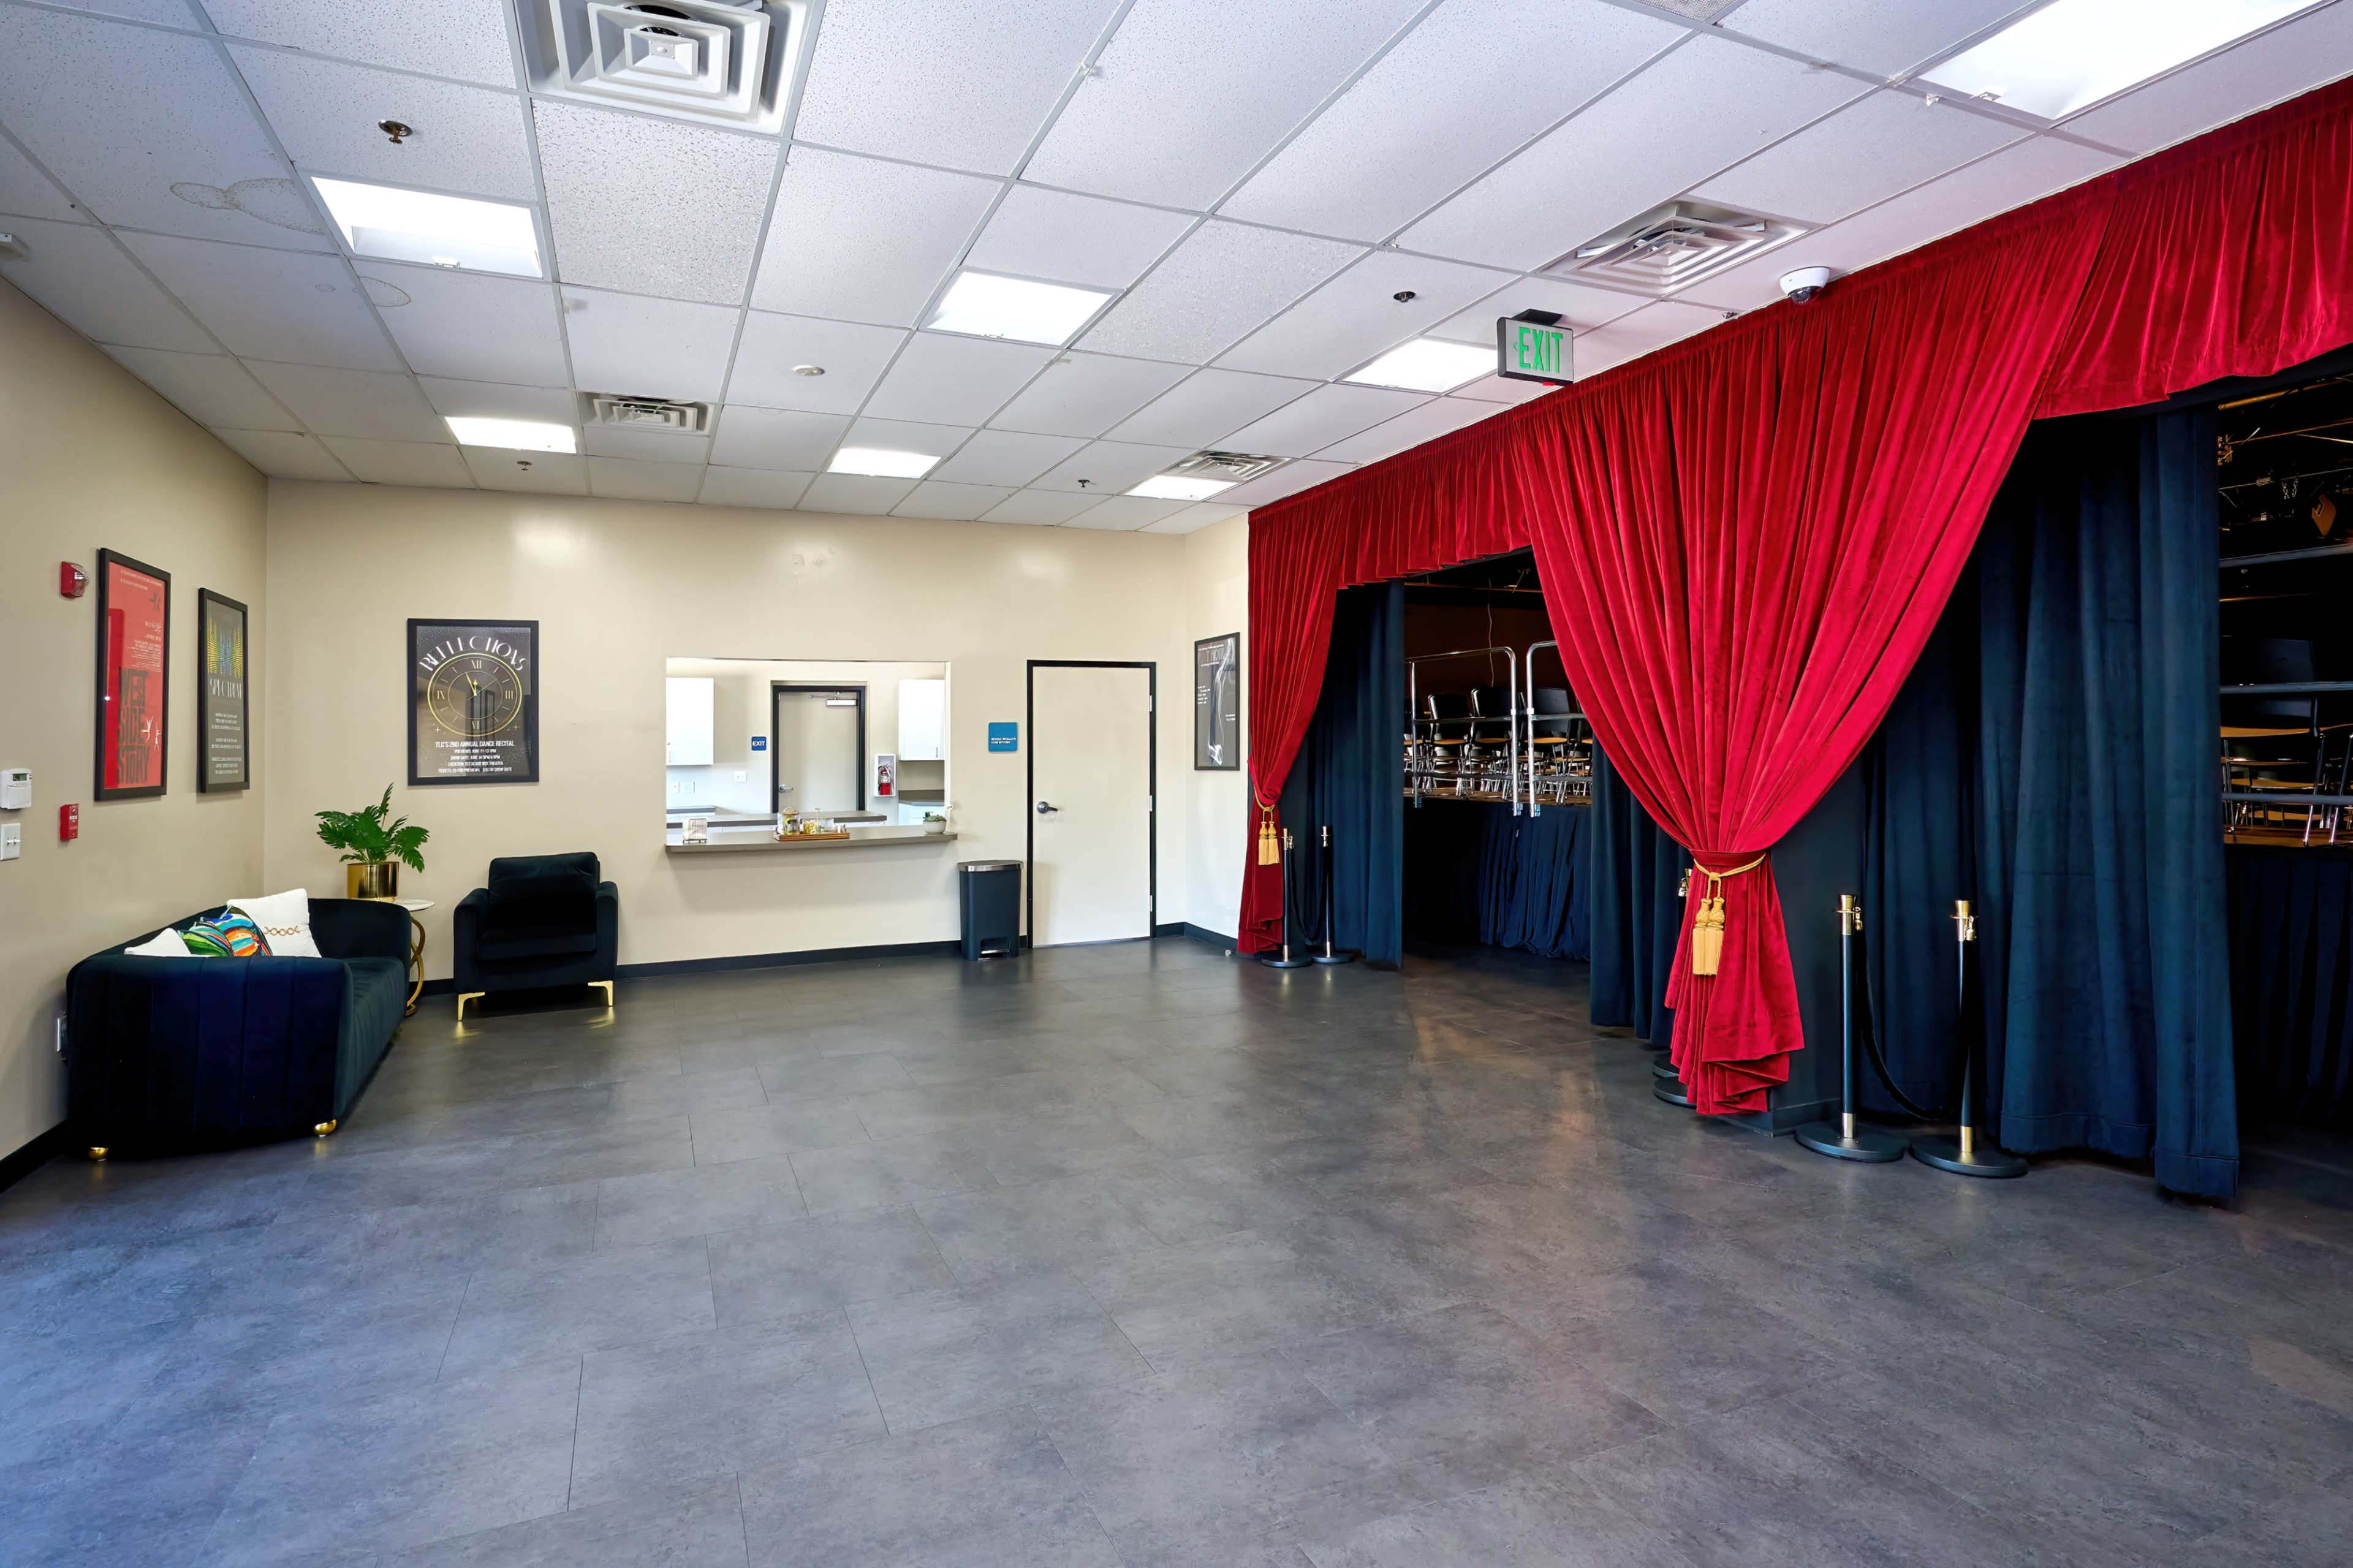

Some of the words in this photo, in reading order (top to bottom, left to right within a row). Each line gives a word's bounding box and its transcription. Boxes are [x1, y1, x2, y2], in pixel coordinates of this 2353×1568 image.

[1518, 327, 1563, 374] EXIT
[118, 667, 149, 706] WEST
[118, 706, 146, 744] SIDE
[116, 744, 151, 784] STORY
